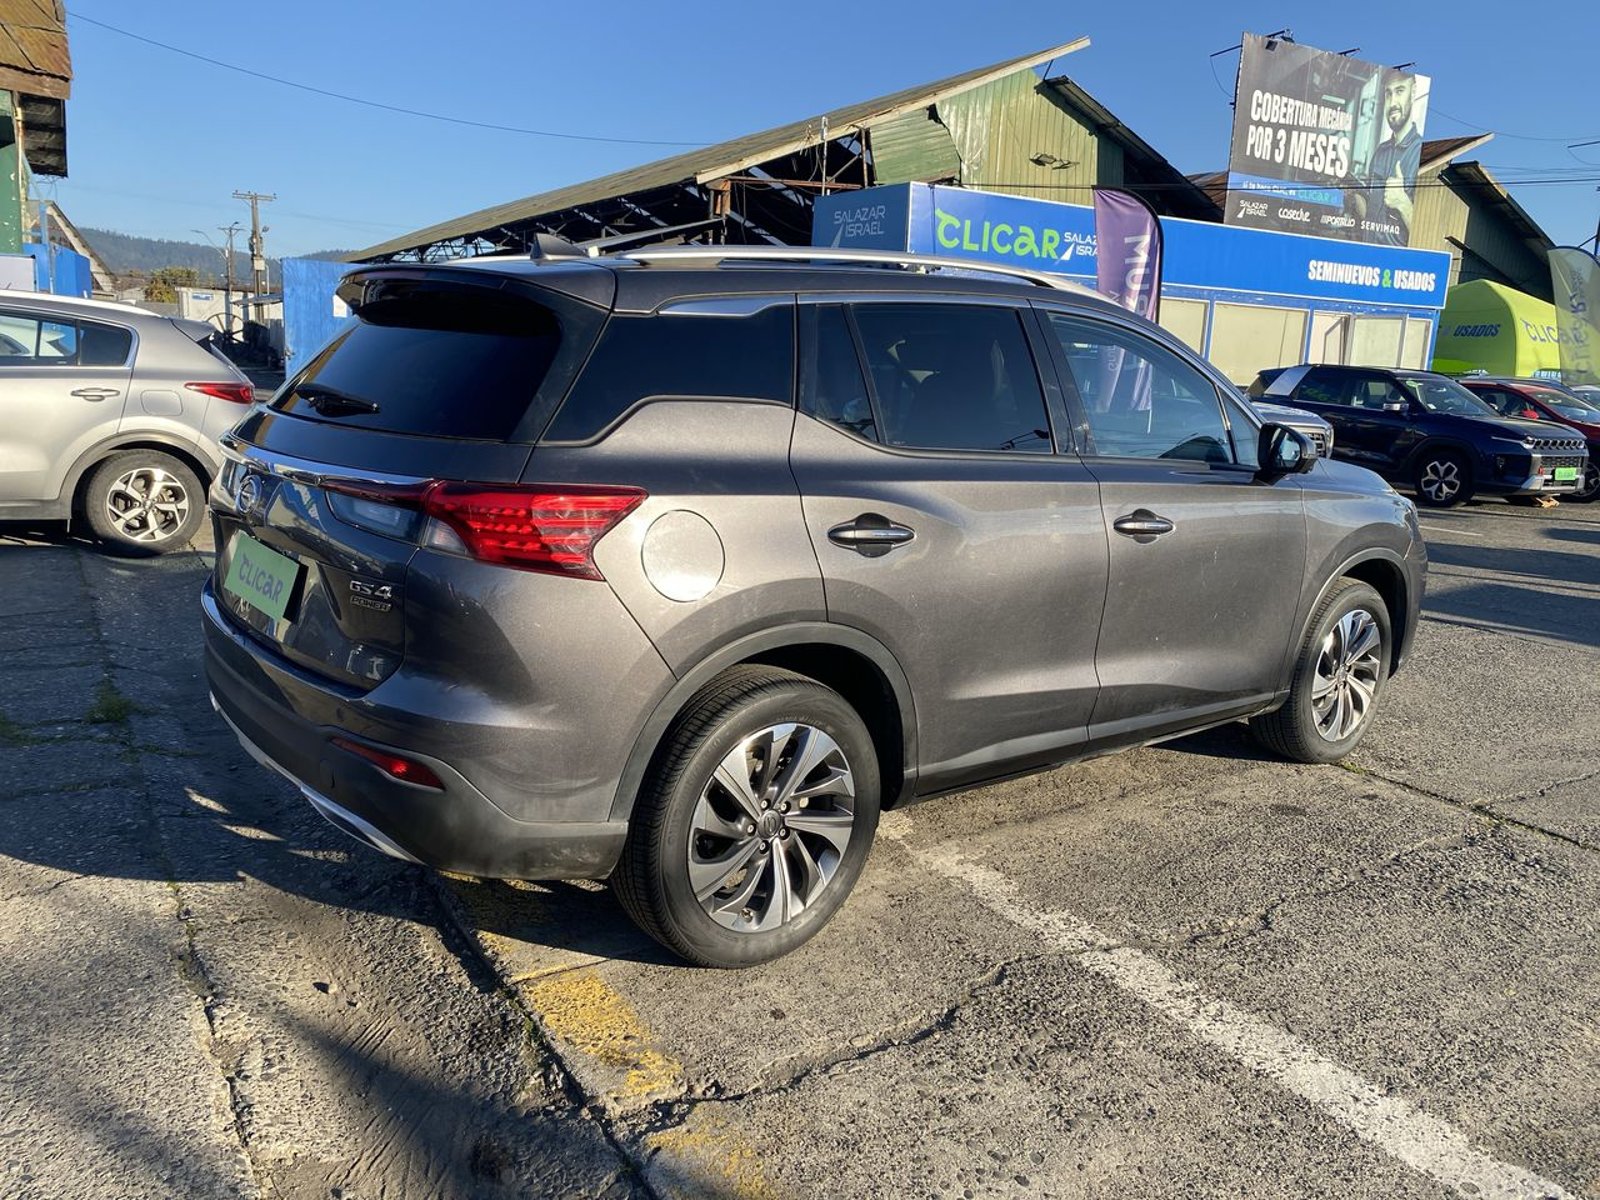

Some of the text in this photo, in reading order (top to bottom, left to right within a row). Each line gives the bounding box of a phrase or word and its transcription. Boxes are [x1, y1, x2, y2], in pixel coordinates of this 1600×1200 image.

[1250, 89, 1318, 128] COBERTURA
[1246, 125, 1350, 178] POR 3 MESES
[834, 205, 886, 224] SALAZAR
[845, 222, 885, 237] ISRAEL
[1360, 220, 1400, 235] SERVIMAQ
[1308, 259, 1436, 292] SEMINUEVOS & USADOS
[1453, 324, 1501, 337] USADOS
